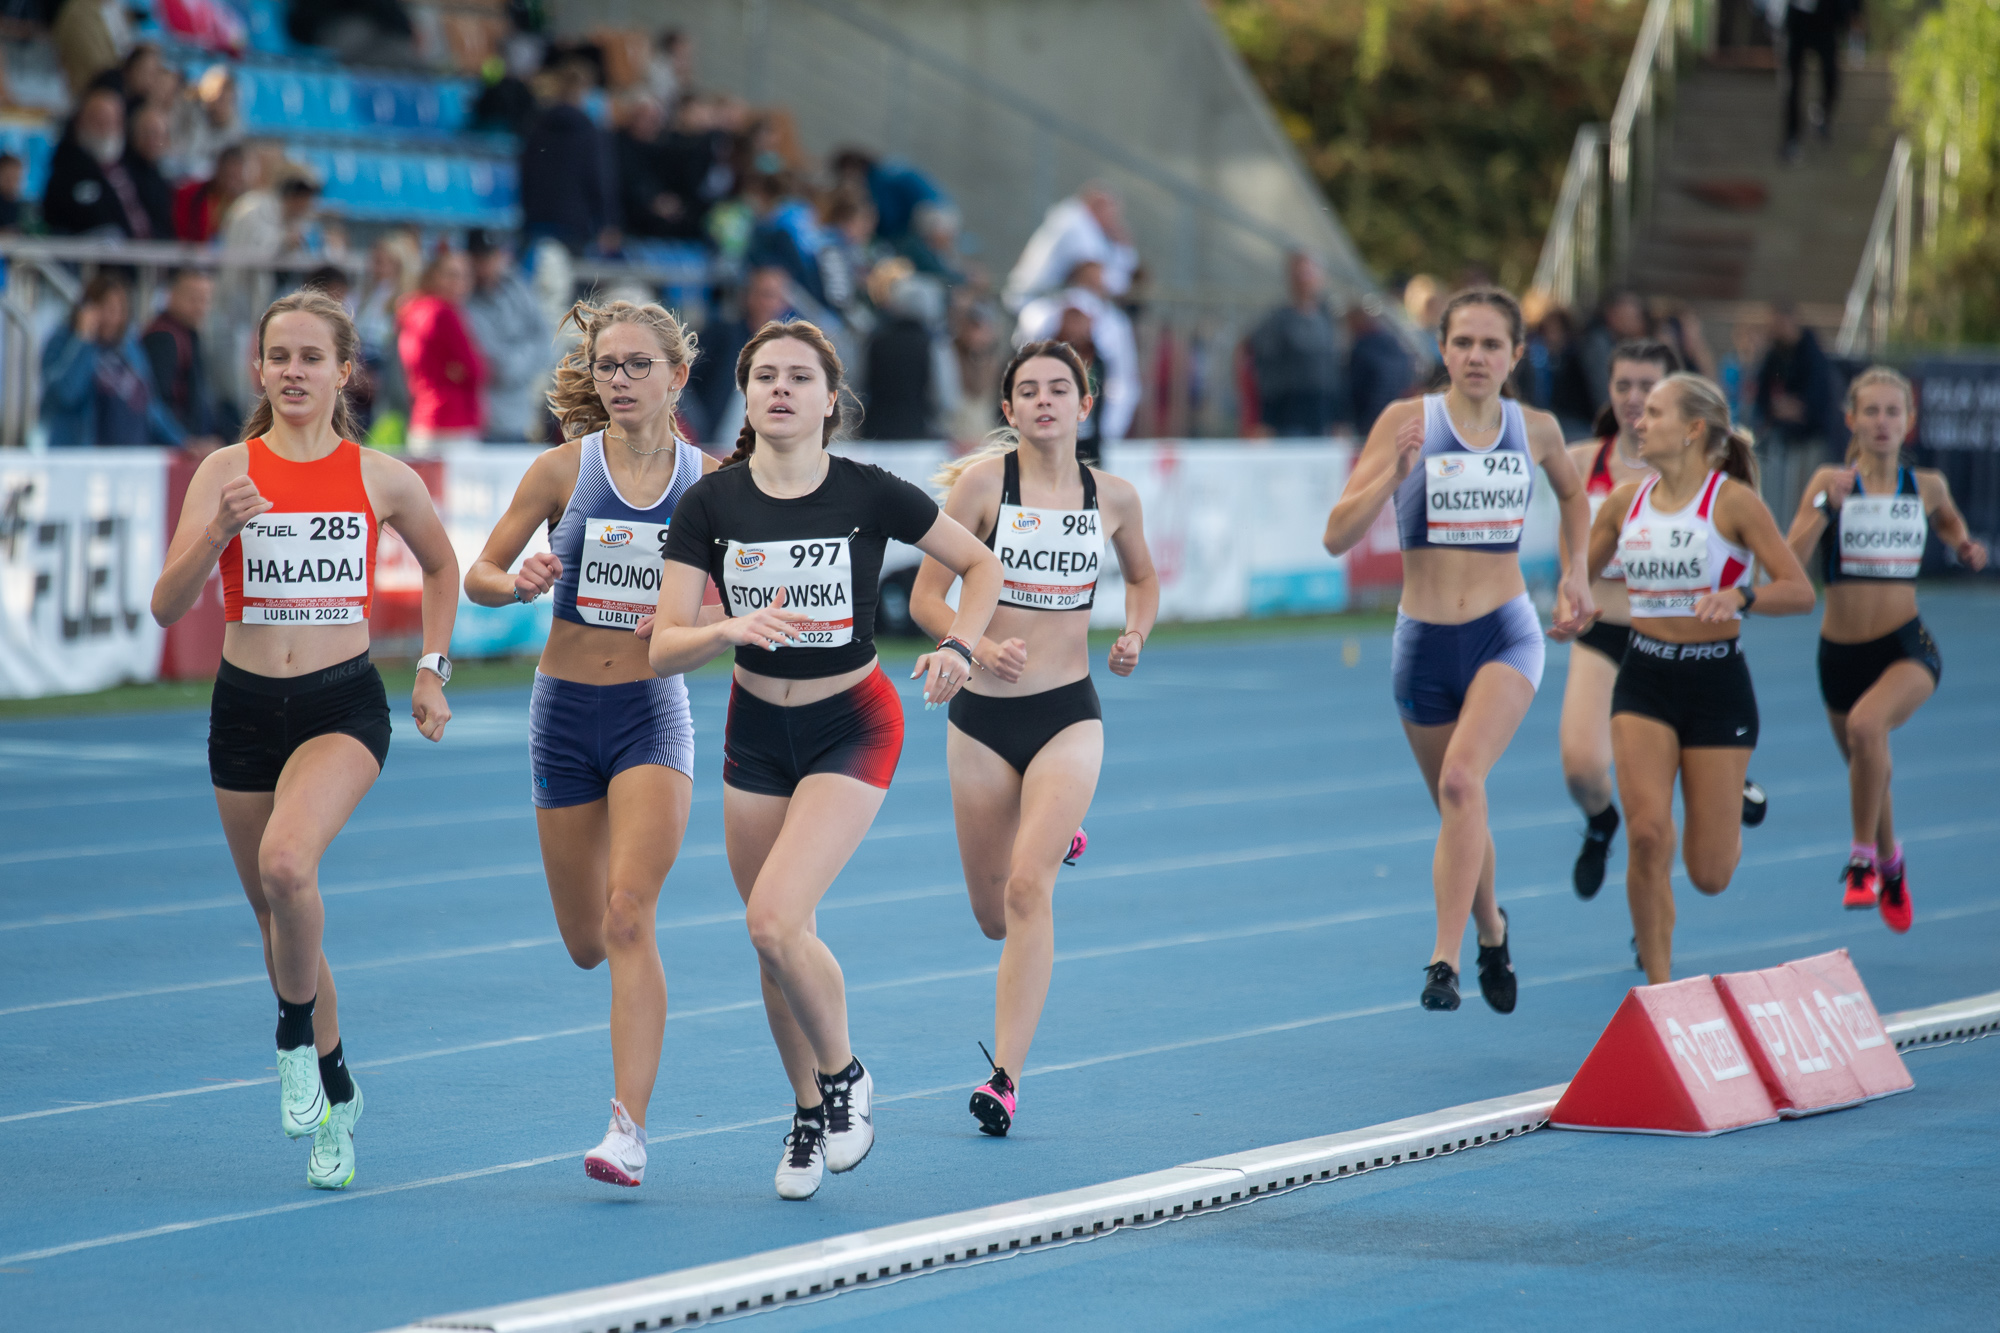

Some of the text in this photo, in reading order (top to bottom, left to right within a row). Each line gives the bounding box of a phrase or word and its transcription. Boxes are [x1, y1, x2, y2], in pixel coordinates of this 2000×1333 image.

[1484, 456, 1522, 476] 942
[1431, 489, 1523, 511] OLSZEWSKA
[257, 525, 298, 537] FUEL
[309, 516, 361, 541] 285
[1062, 514, 1097, 536] 984
[1446, 529, 1514, 541] LUBLIN 2022
[606, 533, 627, 542] LOTTO
[1670, 530, 1694, 548] 57
[740, 555, 760, 565] LOTTO
[789, 542, 841, 569] 997
[1000, 546, 1098, 577] RACIĘDA
[247, 557, 363, 584] HAŁADAJ
[1625, 557, 1701, 580] KARNAŚ
[1011, 590, 1053, 605] LUBLIN
[264, 608, 349, 621] LUBLIN 2022
[1633, 635, 1677, 660] NIKE
[1678, 643, 1730, 662] PRO
[321, 661, 356, 685] NIKE
[1747, 996, 1847, 1077] PZLA
